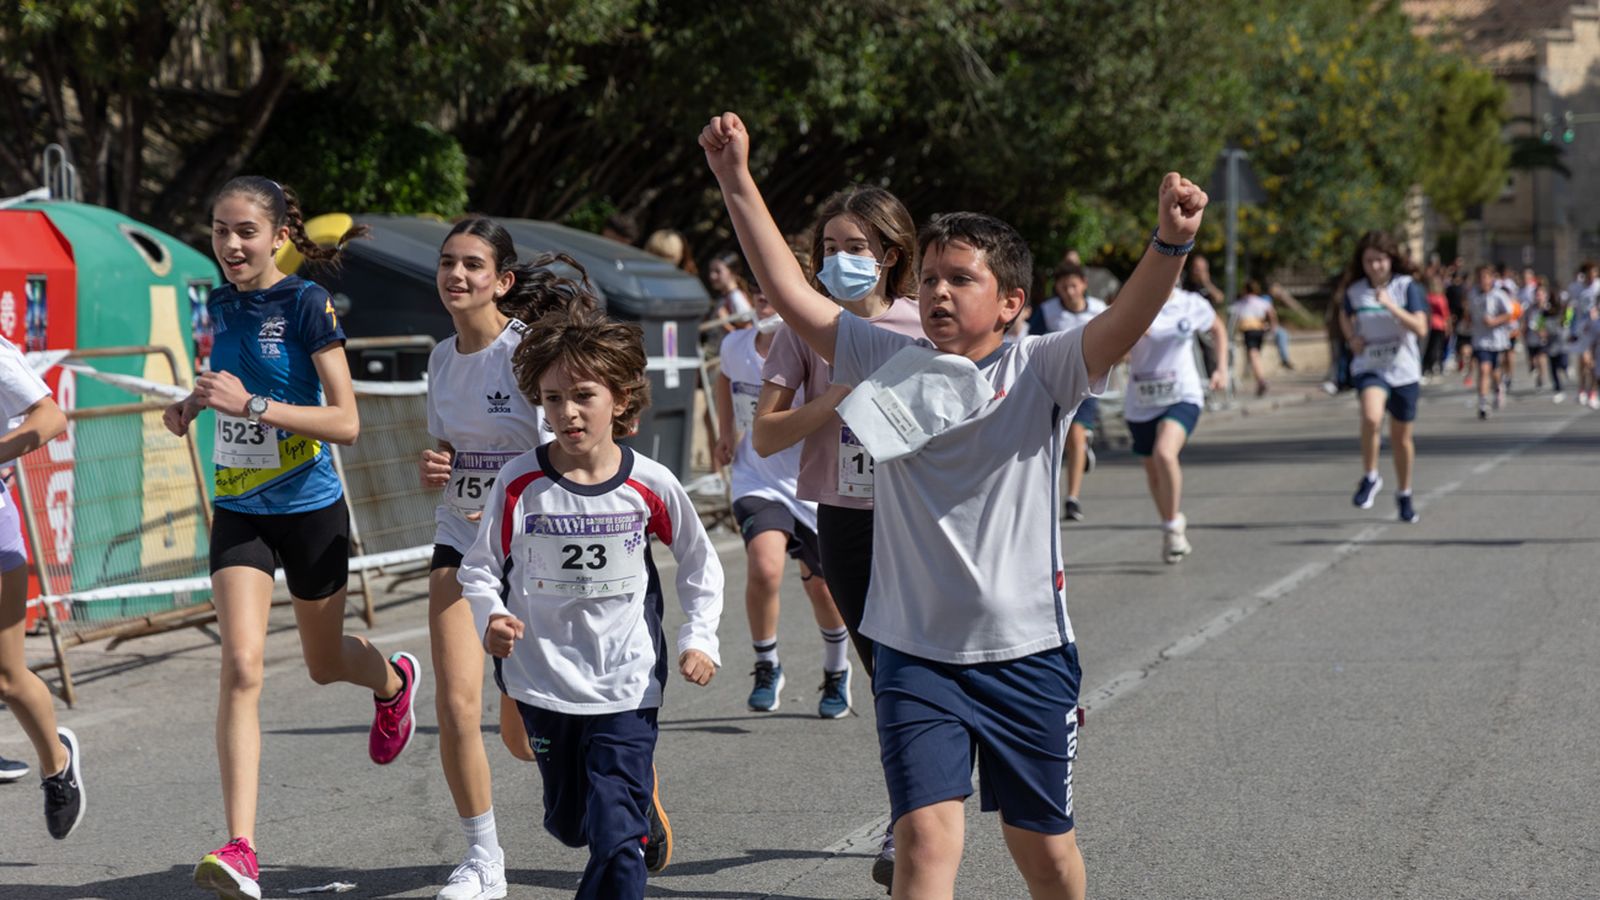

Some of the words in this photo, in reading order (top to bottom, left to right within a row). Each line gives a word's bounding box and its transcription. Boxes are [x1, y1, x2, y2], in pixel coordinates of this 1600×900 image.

[591, 524, 600, 533] LA
[606, 521, 632, 532] GLORIA
[561, 544, 607, 569] 23
